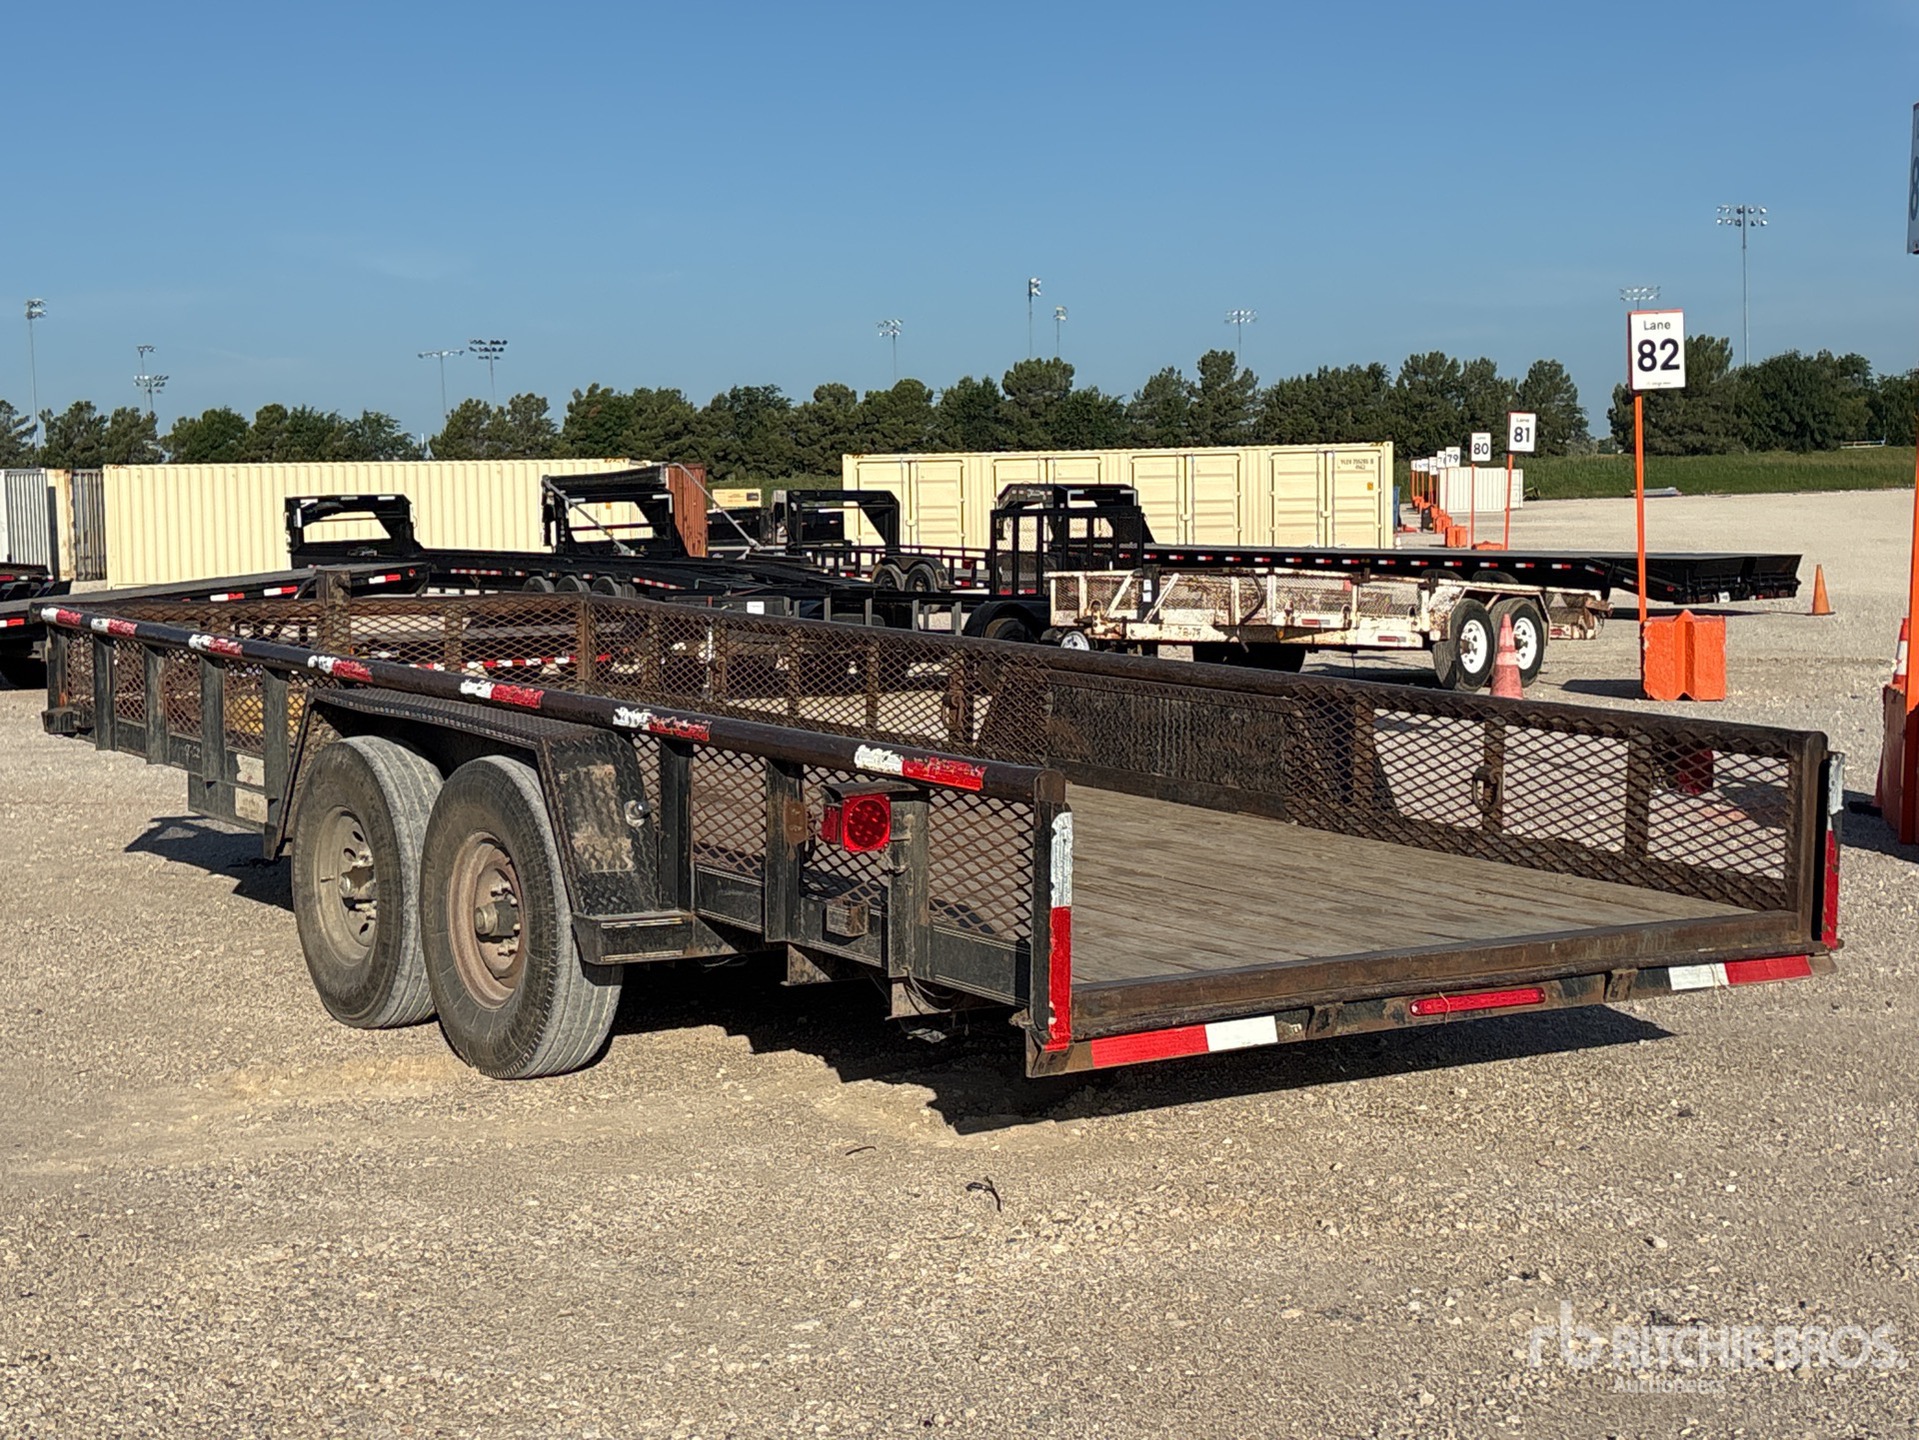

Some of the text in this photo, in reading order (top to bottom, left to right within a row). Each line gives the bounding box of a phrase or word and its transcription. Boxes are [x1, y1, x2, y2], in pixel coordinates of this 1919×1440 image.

[1643, 320, 1671, 331] Lane
[1637, 338, 1680, 372] 82
[1514, 427, 1530, 442] 81
[1473, 443, 1489, 455] 80
[1446, 454, 1459, 463] 79
